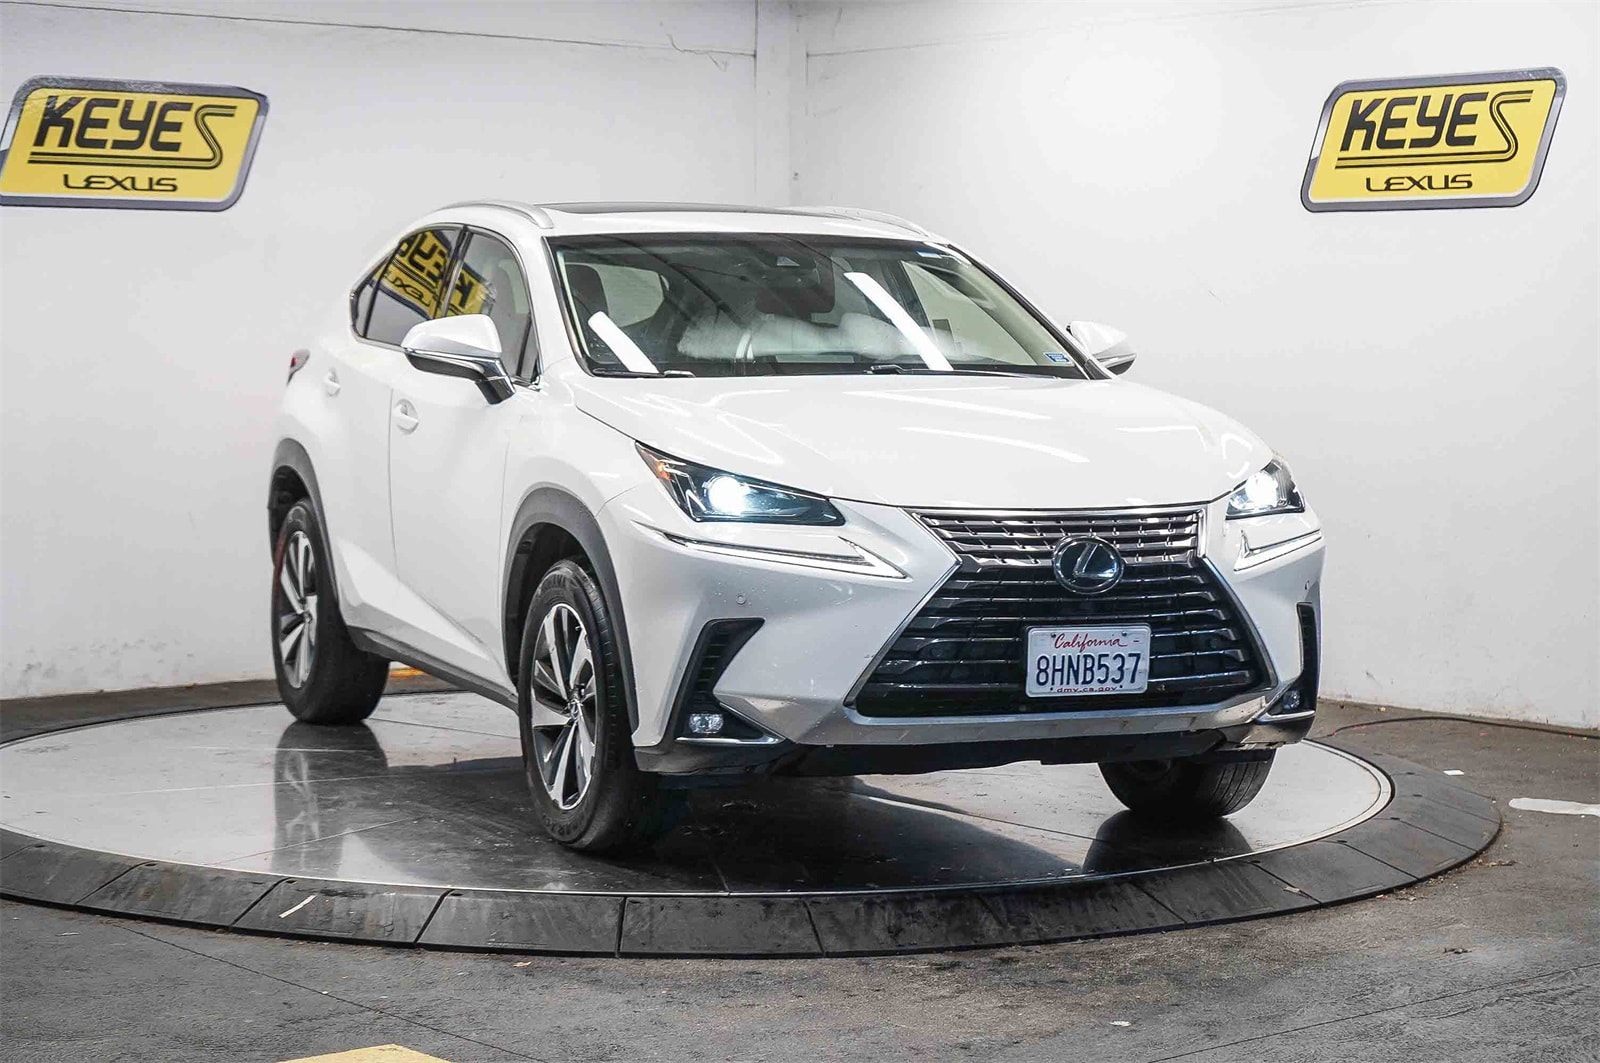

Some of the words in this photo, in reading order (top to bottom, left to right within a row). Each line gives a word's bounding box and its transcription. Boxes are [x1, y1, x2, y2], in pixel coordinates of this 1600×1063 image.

[28, 95, 238, 170] KEYES
[1335, 89, 1534, 169] KEYES
[63, 174, 178, 192] LEXUS
[1365, 174, 1473, 192] LEXUS
[1054, 633, 1128, 652] California
[1036, 653, 1141, 686] 8HNB537
